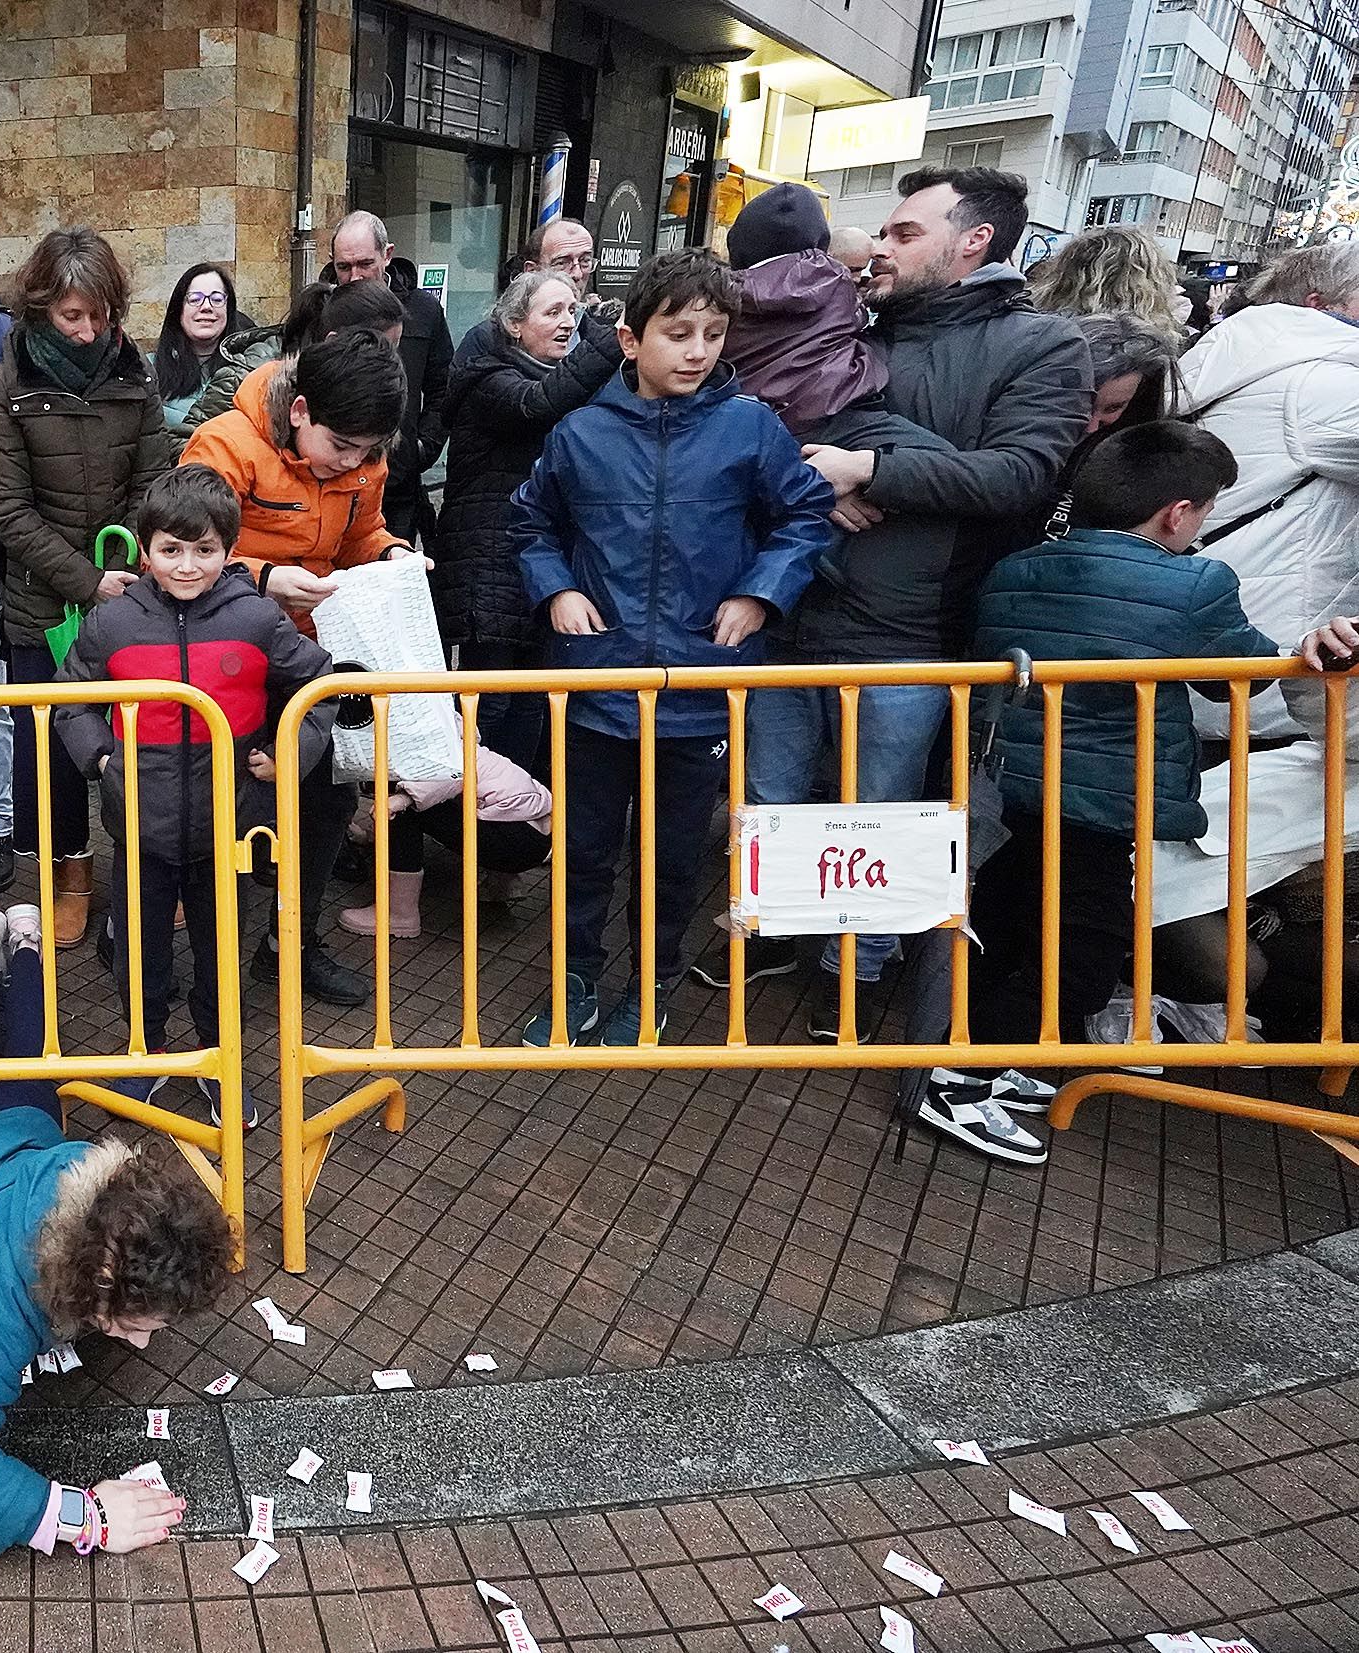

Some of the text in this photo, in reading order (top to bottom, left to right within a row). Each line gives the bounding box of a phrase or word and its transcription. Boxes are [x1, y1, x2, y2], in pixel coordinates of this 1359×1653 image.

[669, 126, 707, 161] ARBERÍA
[600, 247, 641, 268] CARLOS CONDE
[1053, 489, 1074, 522] BIM
[817, 846, 889, 900] fila
[153, 1413, 162, 1437] FROI
[257, 1502, 268, 1533] FROIZ
[505, 1613, 529, 1652] FROIZ
